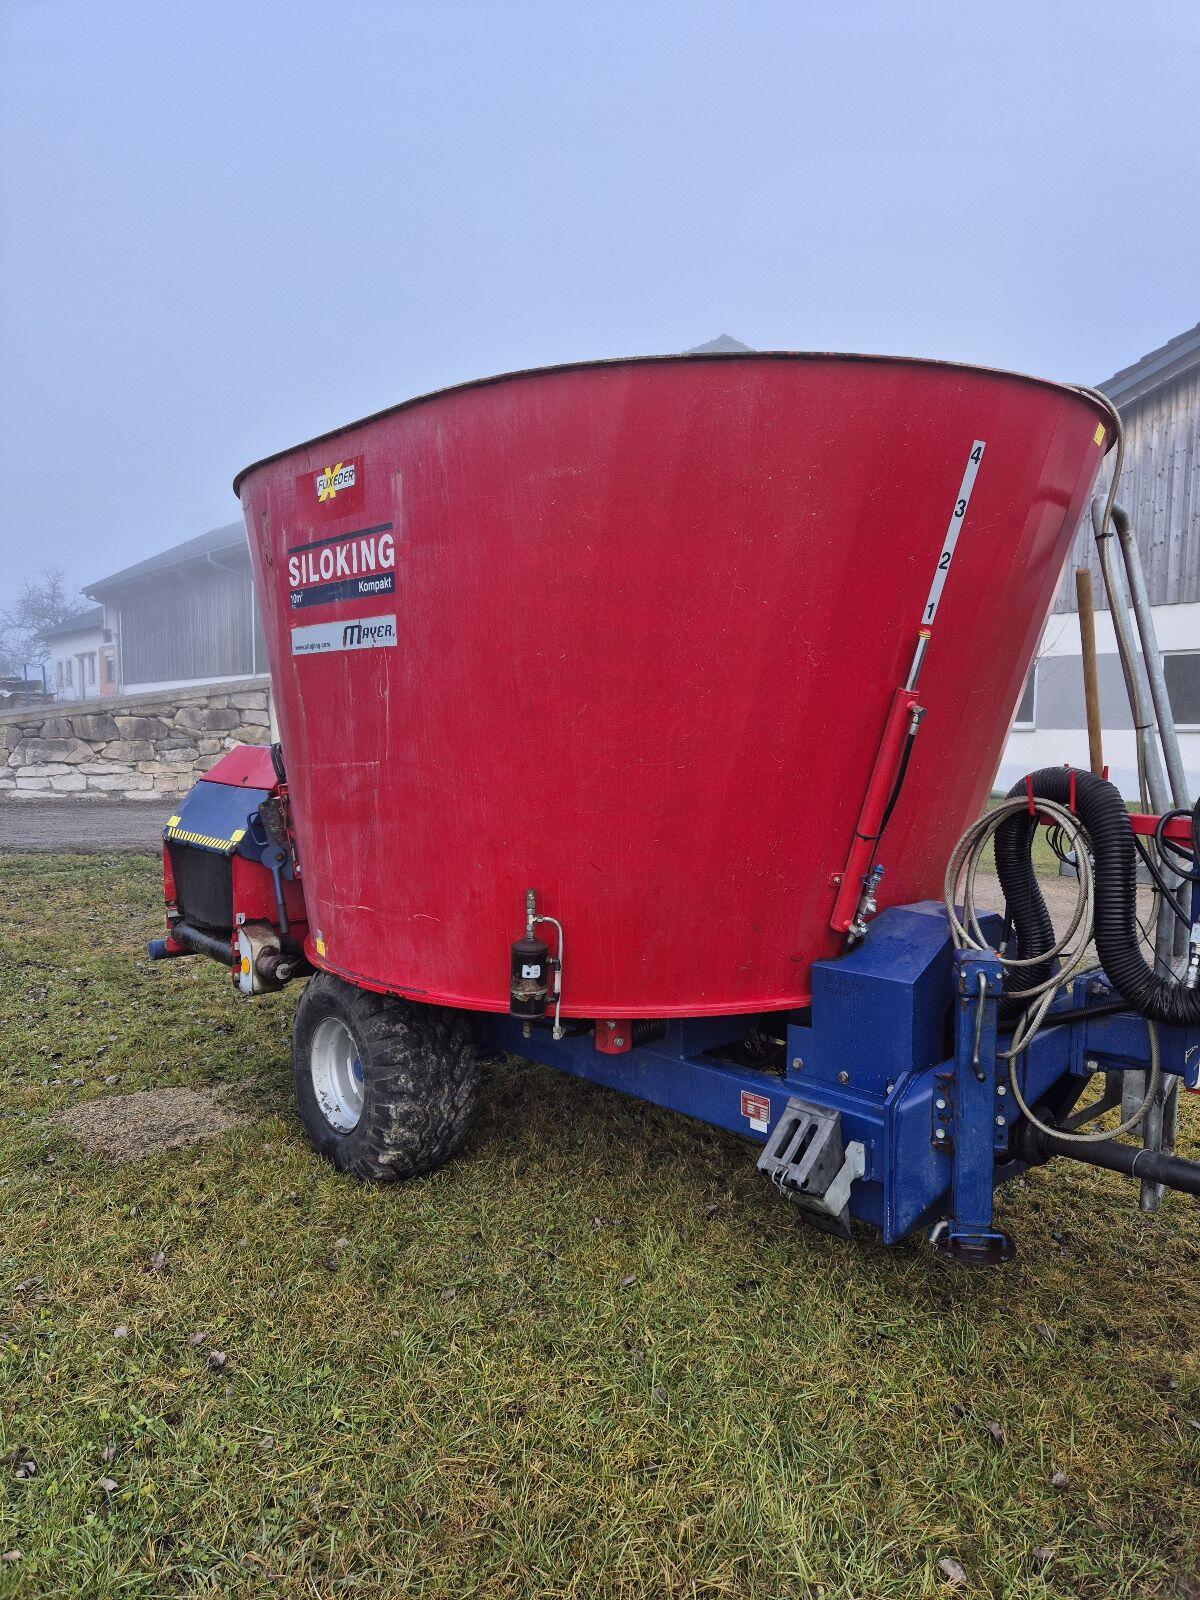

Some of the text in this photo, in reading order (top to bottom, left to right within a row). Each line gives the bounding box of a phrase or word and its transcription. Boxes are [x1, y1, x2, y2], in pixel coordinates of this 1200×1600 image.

[970, 446, 982, 465] 4
[954, 499, 967, 518] 3
[288, 533, 395, 587] SILOKING
[939, 551, 951, 570] 2
[358, 576, 392, 593] Kompakt
[927, 602, 935, 620] 1
[343, 624, 393, 647] MAYER
